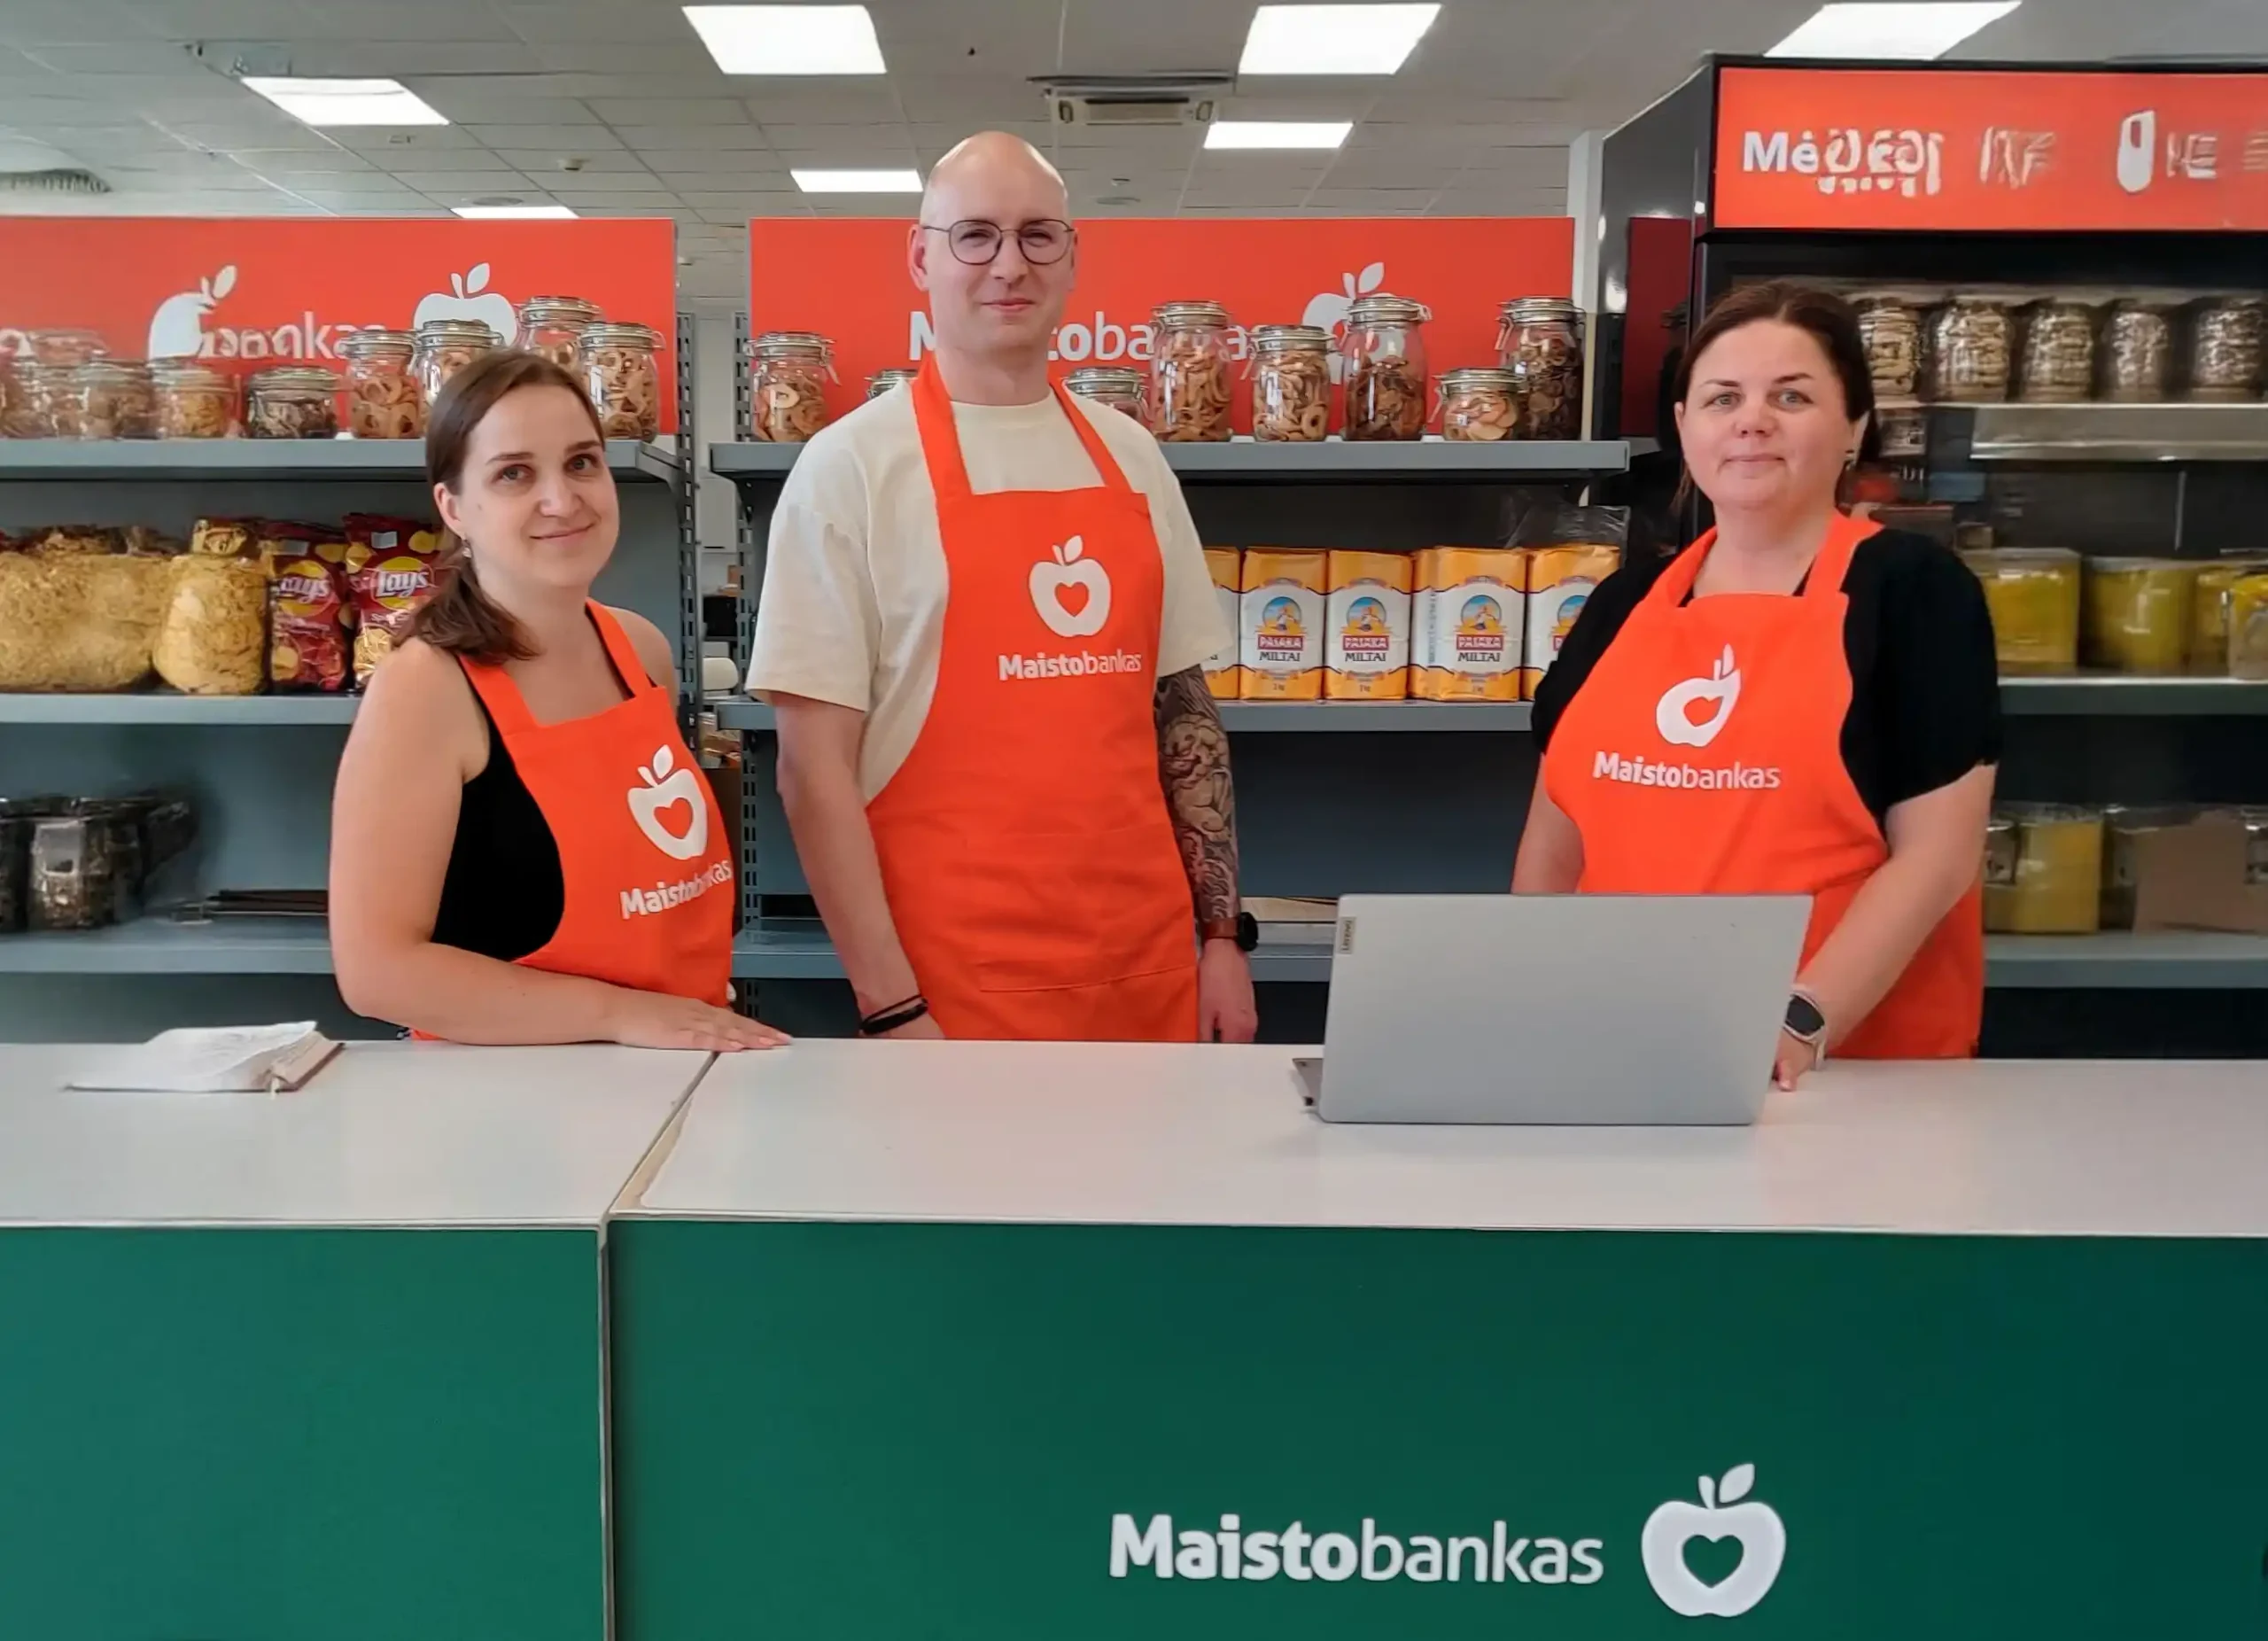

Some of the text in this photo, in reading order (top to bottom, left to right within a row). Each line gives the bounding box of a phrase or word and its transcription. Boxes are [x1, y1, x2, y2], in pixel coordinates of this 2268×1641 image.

[998, 649, 1142, 681] Maistobankas
[1259, 652, 1301, 662] MILTAI
[1345, 652, 1386, 662] MILTAI
[1457, 652, 1501, 662] MILTAI
[1593, 751, 1781, 789] Maistobankas
[1109, 1513, 1604, 1585] Maistobankas
